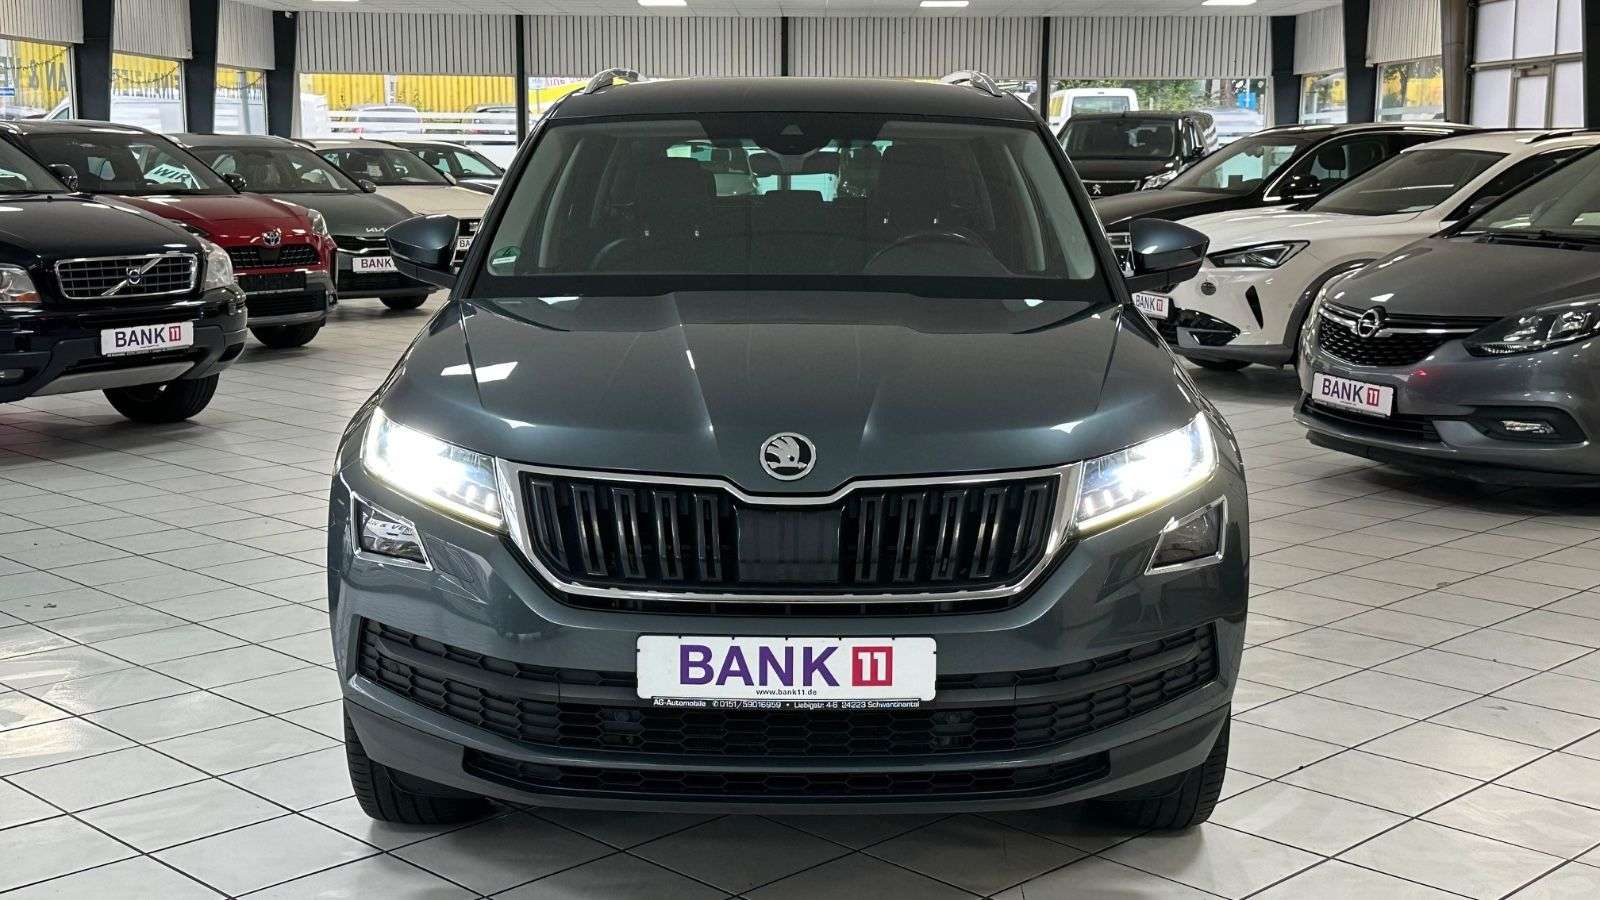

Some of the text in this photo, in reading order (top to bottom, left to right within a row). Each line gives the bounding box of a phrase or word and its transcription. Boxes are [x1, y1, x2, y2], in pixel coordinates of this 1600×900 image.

[361, 258, 392, 269] BANK
[1136, 295, 1155, 311] BANK
[115, 326, 181, 348] BANK 11
[1322, 378, 1379, 406] BANK 11
[679, 644, 891, 687] BANK 11
[756, 688, 817, 697] www.bank11.de
[653, 698, 707, 708] AG-Automobile
[841, 701, 866, 709] 24223
